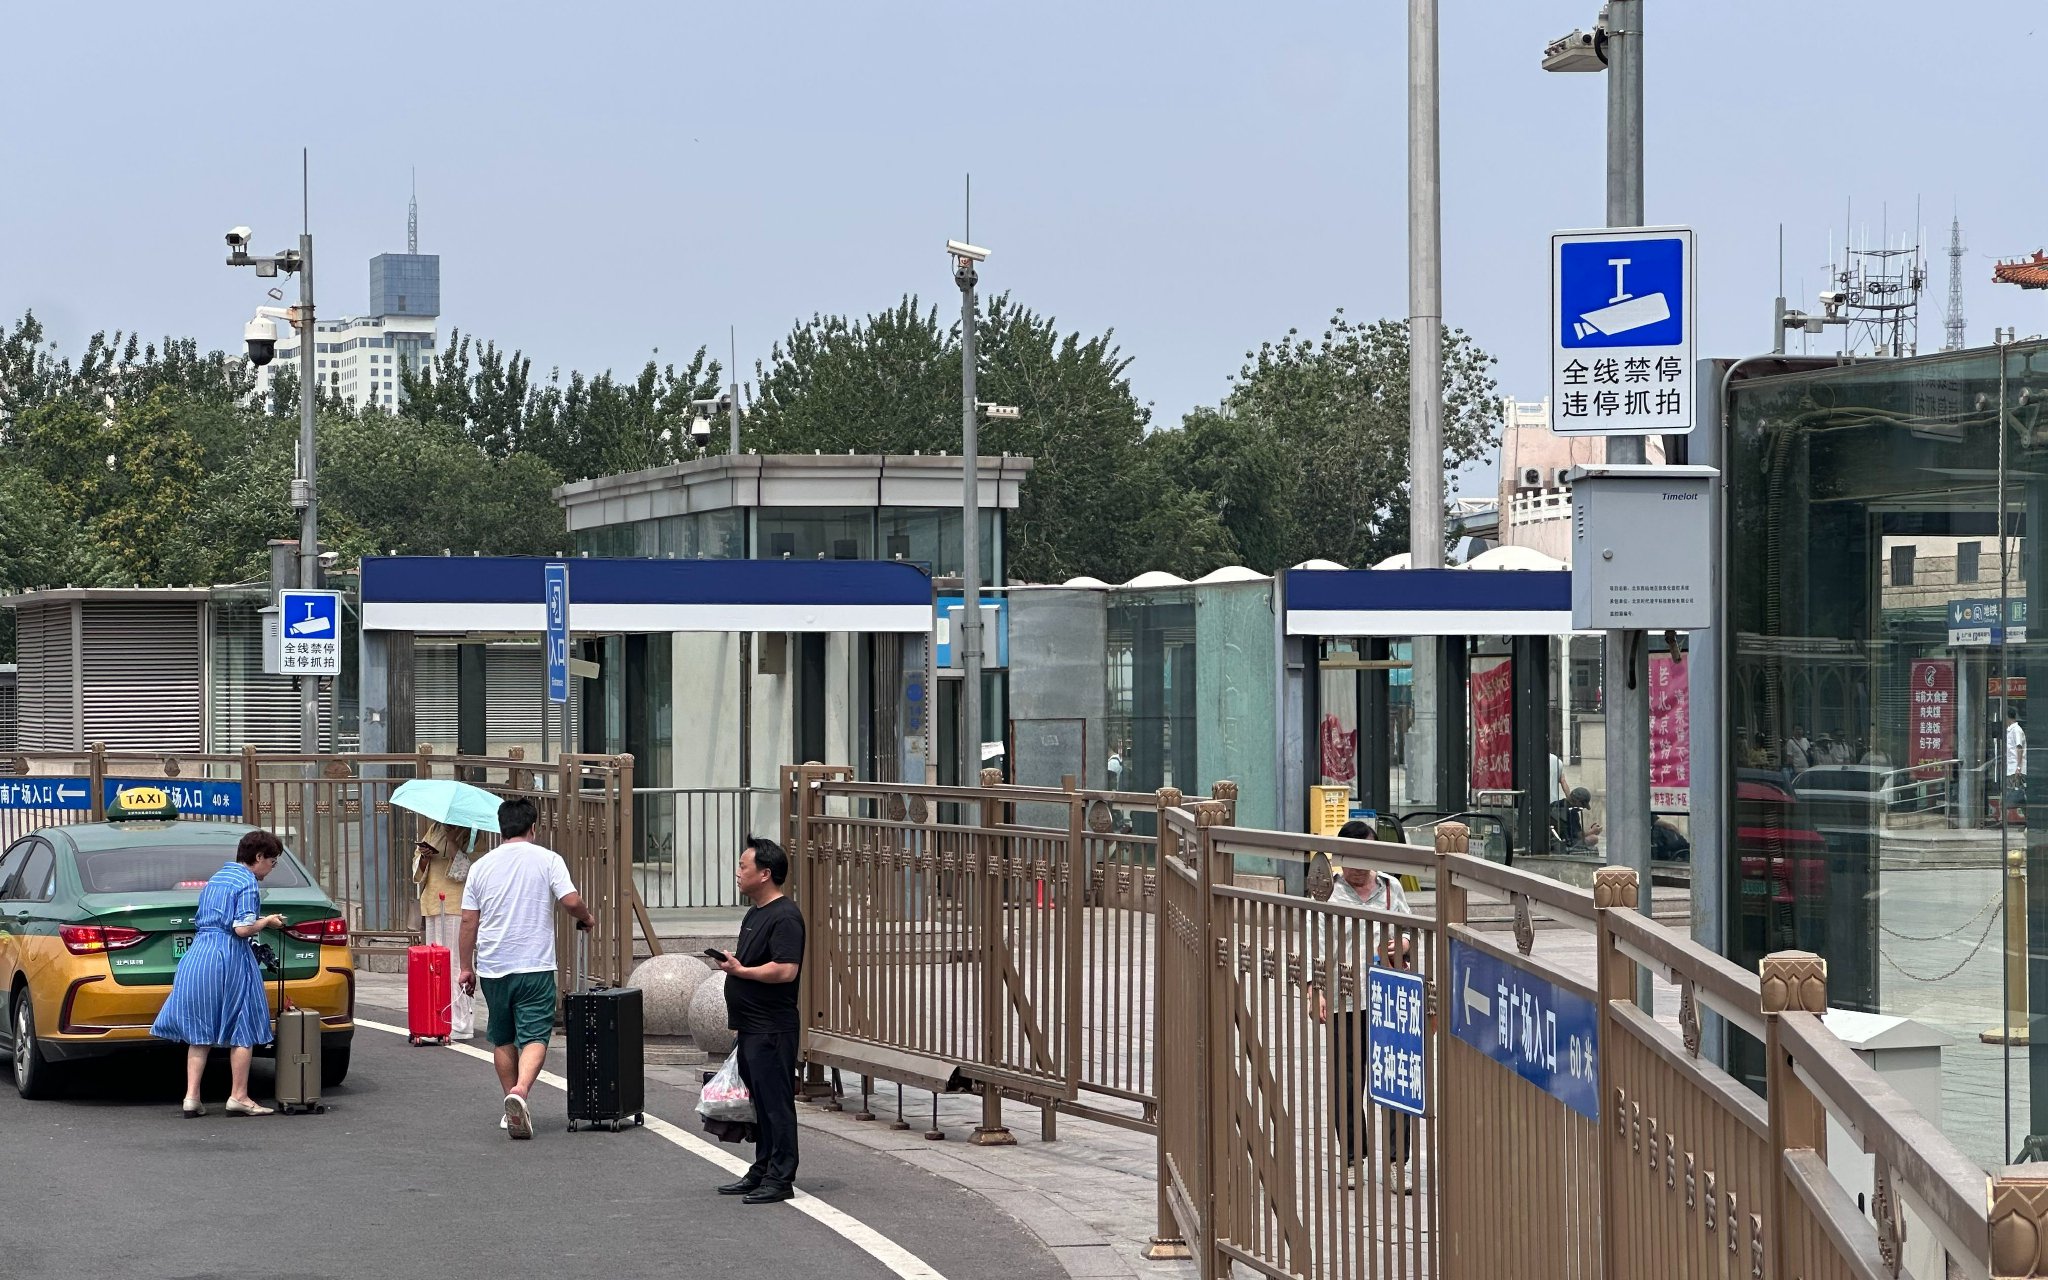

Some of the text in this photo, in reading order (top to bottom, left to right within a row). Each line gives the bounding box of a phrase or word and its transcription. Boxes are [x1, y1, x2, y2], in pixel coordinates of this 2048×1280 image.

[1562, 355, 1682, 385] 全线禁停
[1562, 388, 1681, 418] 违停抓拍
[284, 642, 335, 655] 全线禁停
[284, 656, 335, 668] 违停抓拍
[550, 634, 565, 667] 入口
[1658, 665, 1672, 783] 老北京特产
[1920, 722, 1941, 734] 盖浇饭
[1919, 737, 1941, 750] 包子粥
[0, 782, 52, 804] 南广场入口
[126, 793, 161, 805] TAXI
[1371, 979, 1421, 1037] 禁止停放
[1497, 977, 1557, 1074] 南广场入口
[1371, 1040, 1422, 1100] 各种车辆
